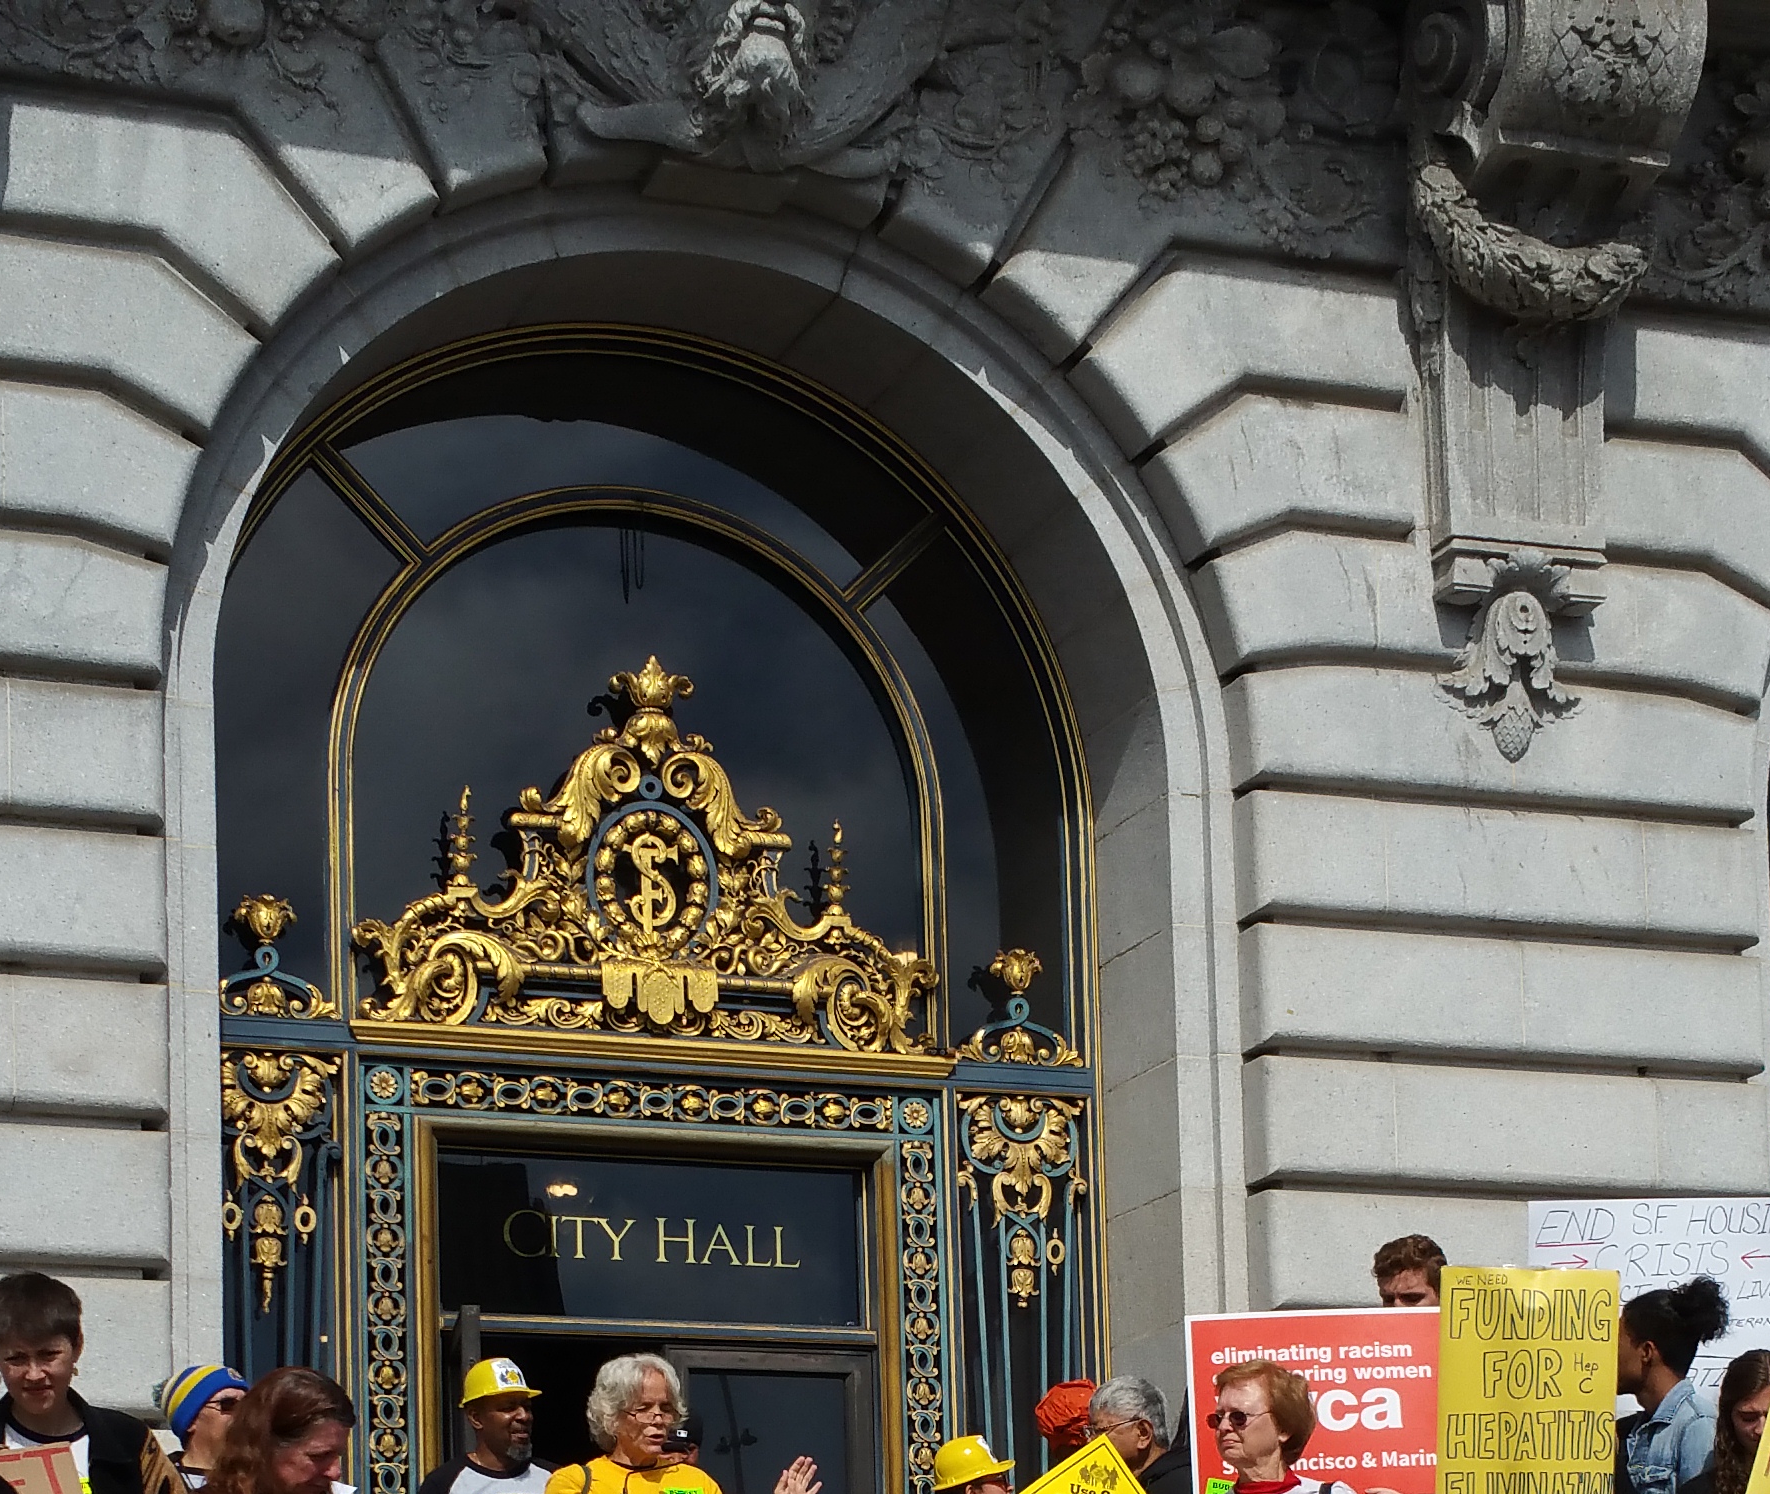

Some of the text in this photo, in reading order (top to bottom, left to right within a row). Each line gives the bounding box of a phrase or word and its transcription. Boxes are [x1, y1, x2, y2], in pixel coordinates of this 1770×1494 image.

[503, 1209, 801, 1268] CITY HALL
[1535, 1207, 1615, 1244] END
[1595, 1240, 1729, 1277] CRISIS
[1455, 1274, 1508, 1286] WE NEED
[1449, 1288, 1612, 1341] FUNDING
[1211, 1341, 1413, 1366] eliminating racism
[1353, 1364, 1432, 1380] women
[1483, 1348, 1599, 1400] FOR Hep
[1579, 1377, 1593, 1394] C
[1447, 1410, 1616, 1461] HEPATITIS
[1296, 1449, 1437, 1471] ncisco & Marin
